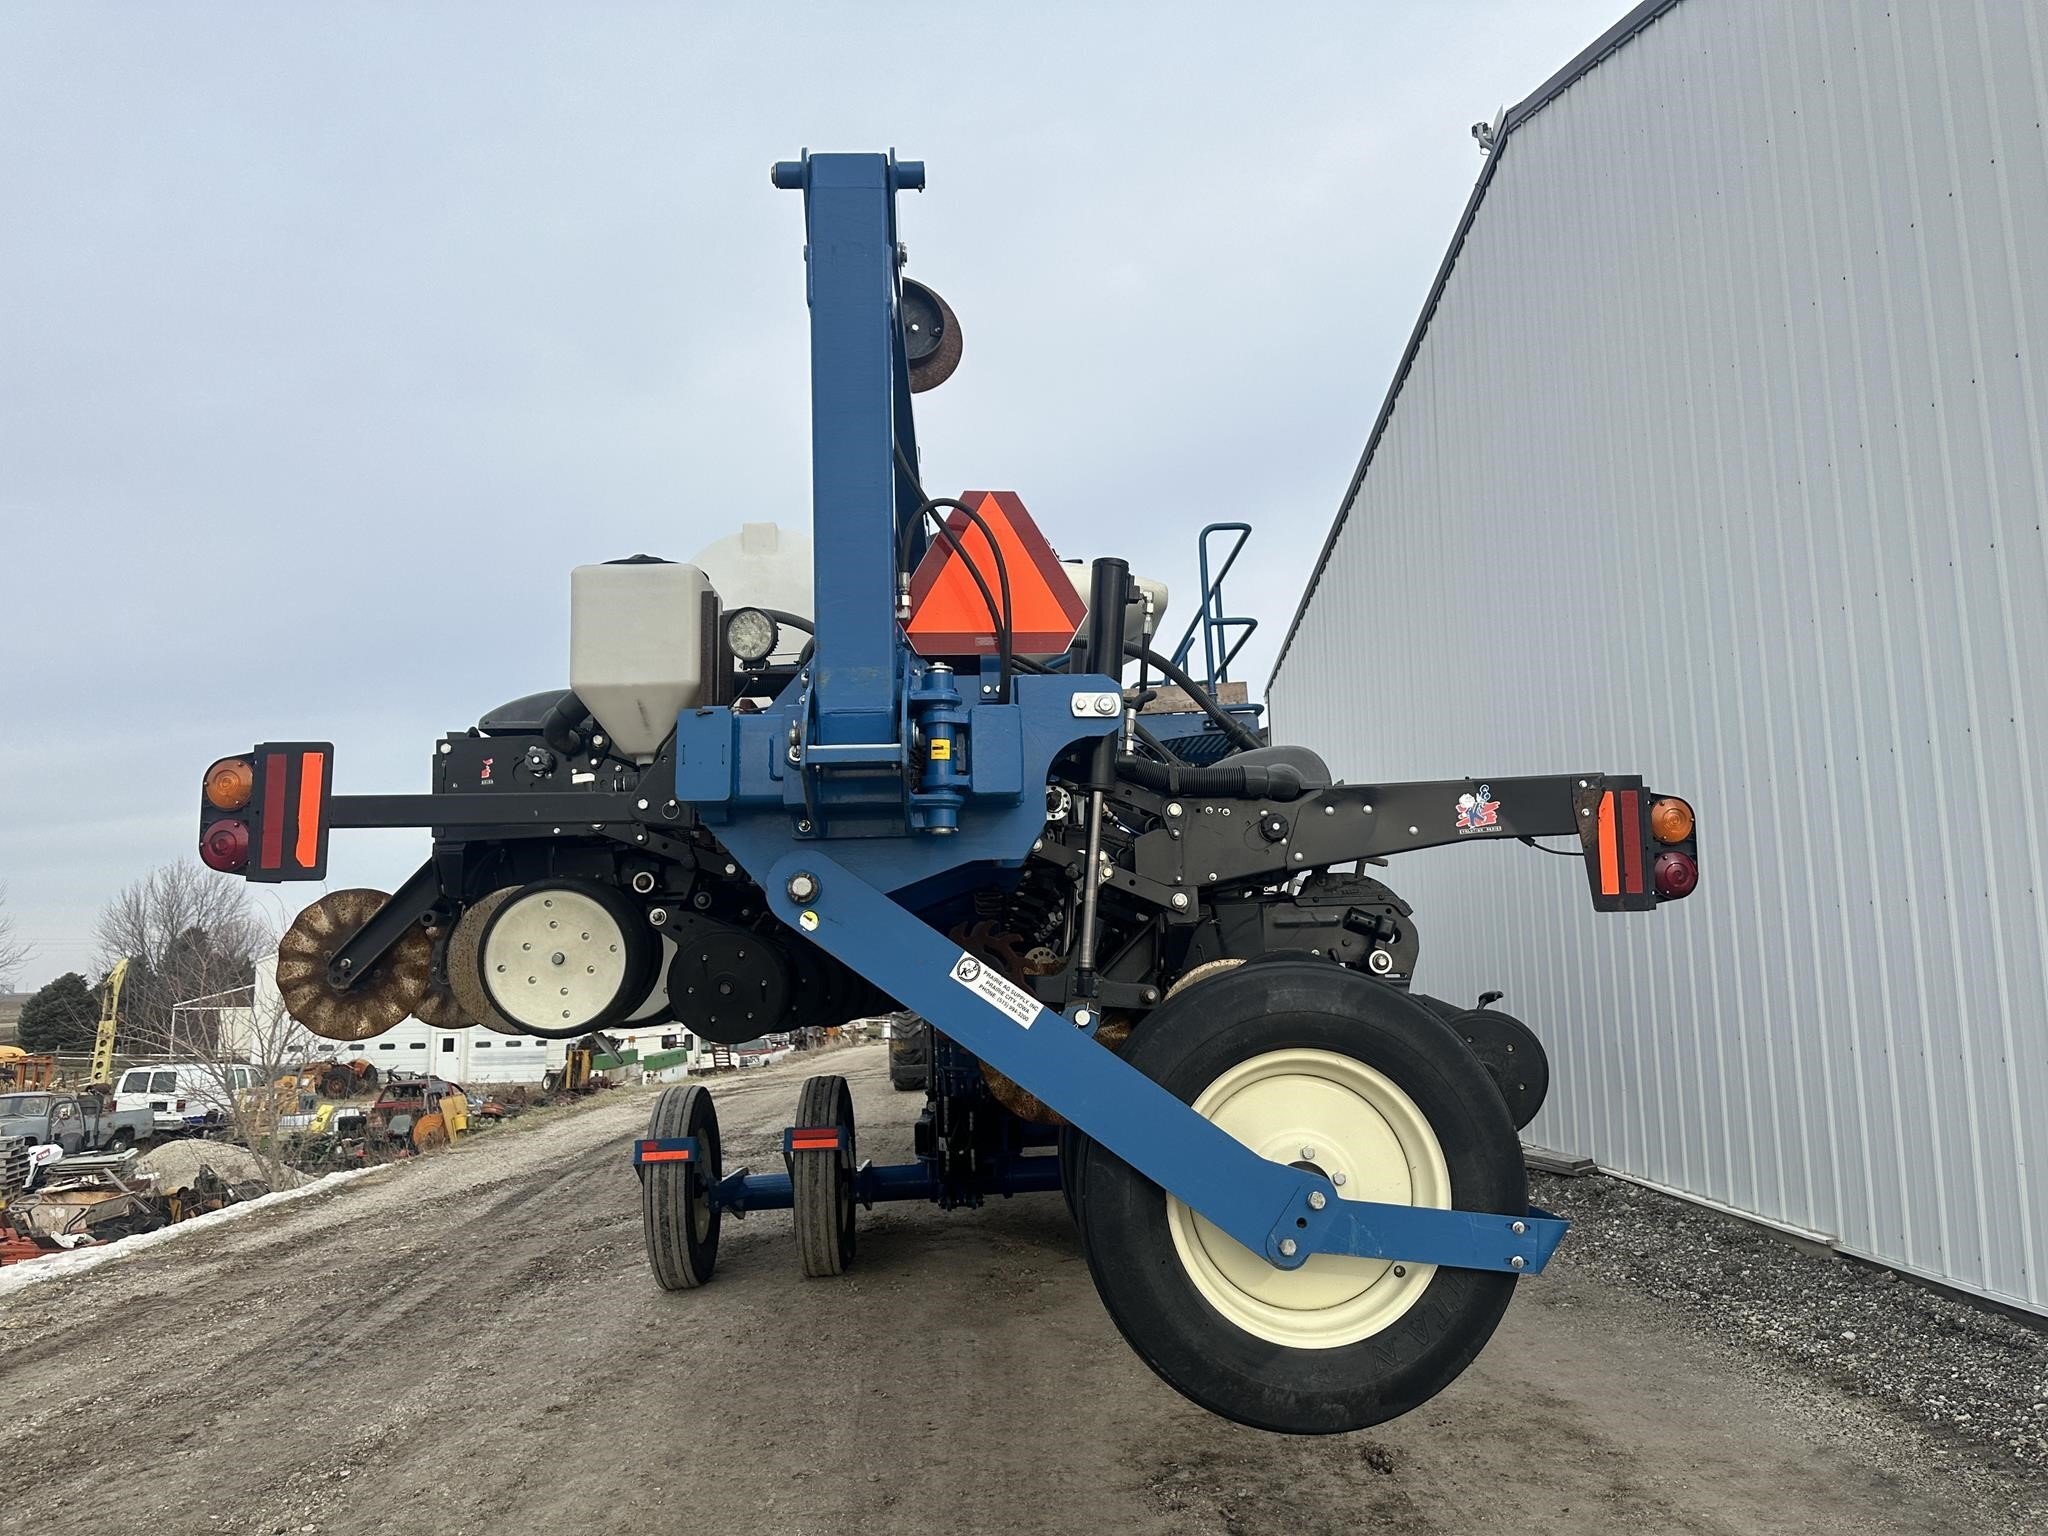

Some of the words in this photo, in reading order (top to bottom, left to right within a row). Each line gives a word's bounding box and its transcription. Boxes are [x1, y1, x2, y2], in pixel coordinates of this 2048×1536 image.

[983, 970, 1004, 987] PRAIRIE
[1003, 984, 1011, 992] AG
[985, 980, 1006, 997] PRAIRIE
[1016, 1002, 1030, 1014] IOWA
